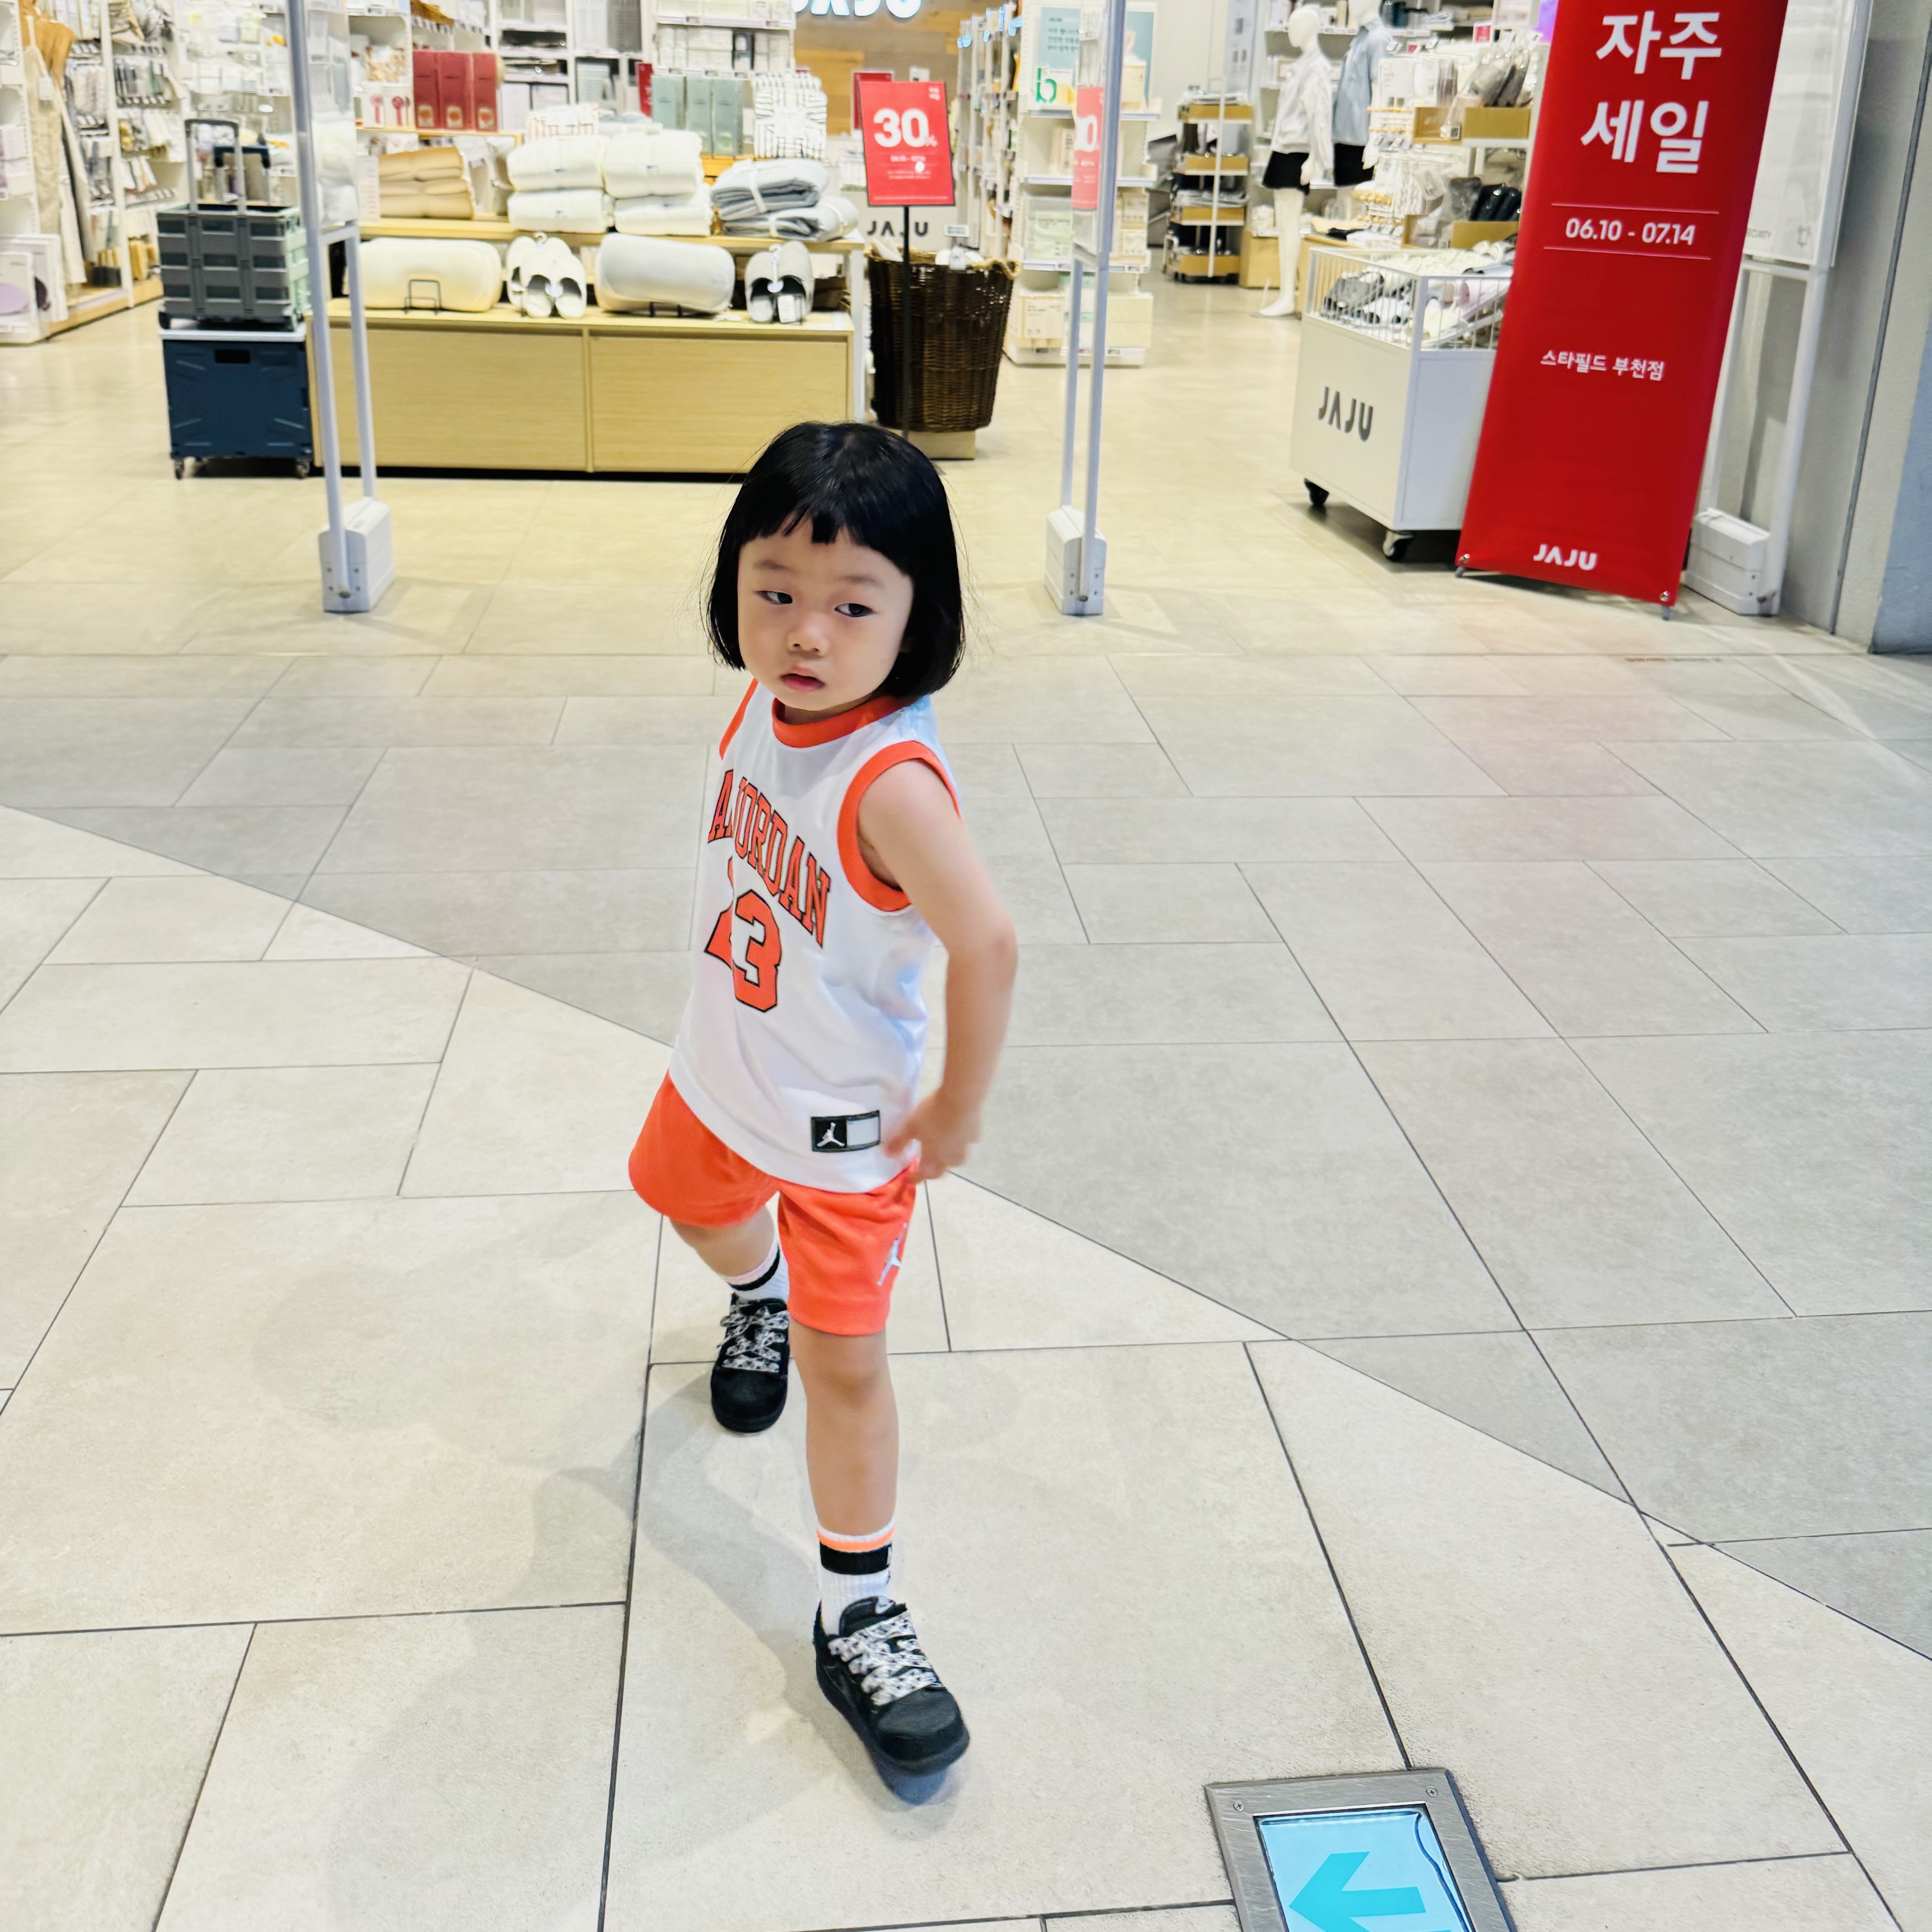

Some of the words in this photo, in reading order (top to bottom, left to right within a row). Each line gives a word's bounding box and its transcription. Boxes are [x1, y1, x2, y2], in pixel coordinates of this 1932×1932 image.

[1595, 10, 1722, 80] 자주
[1580, 99, 1709, 174] 세일
[867, 221, 928, 237] JAU
[1565, 217, 1622, 241] 06.10
[1641, 222, 1696, 246] 07.14
[1540, 350, 1607, 373] 스타필드
[1612, 357, 1665, 382] 부천점
[1318, 386, 1374, 442] JAJU
[1533, 543, 1598, 571] JAJU
